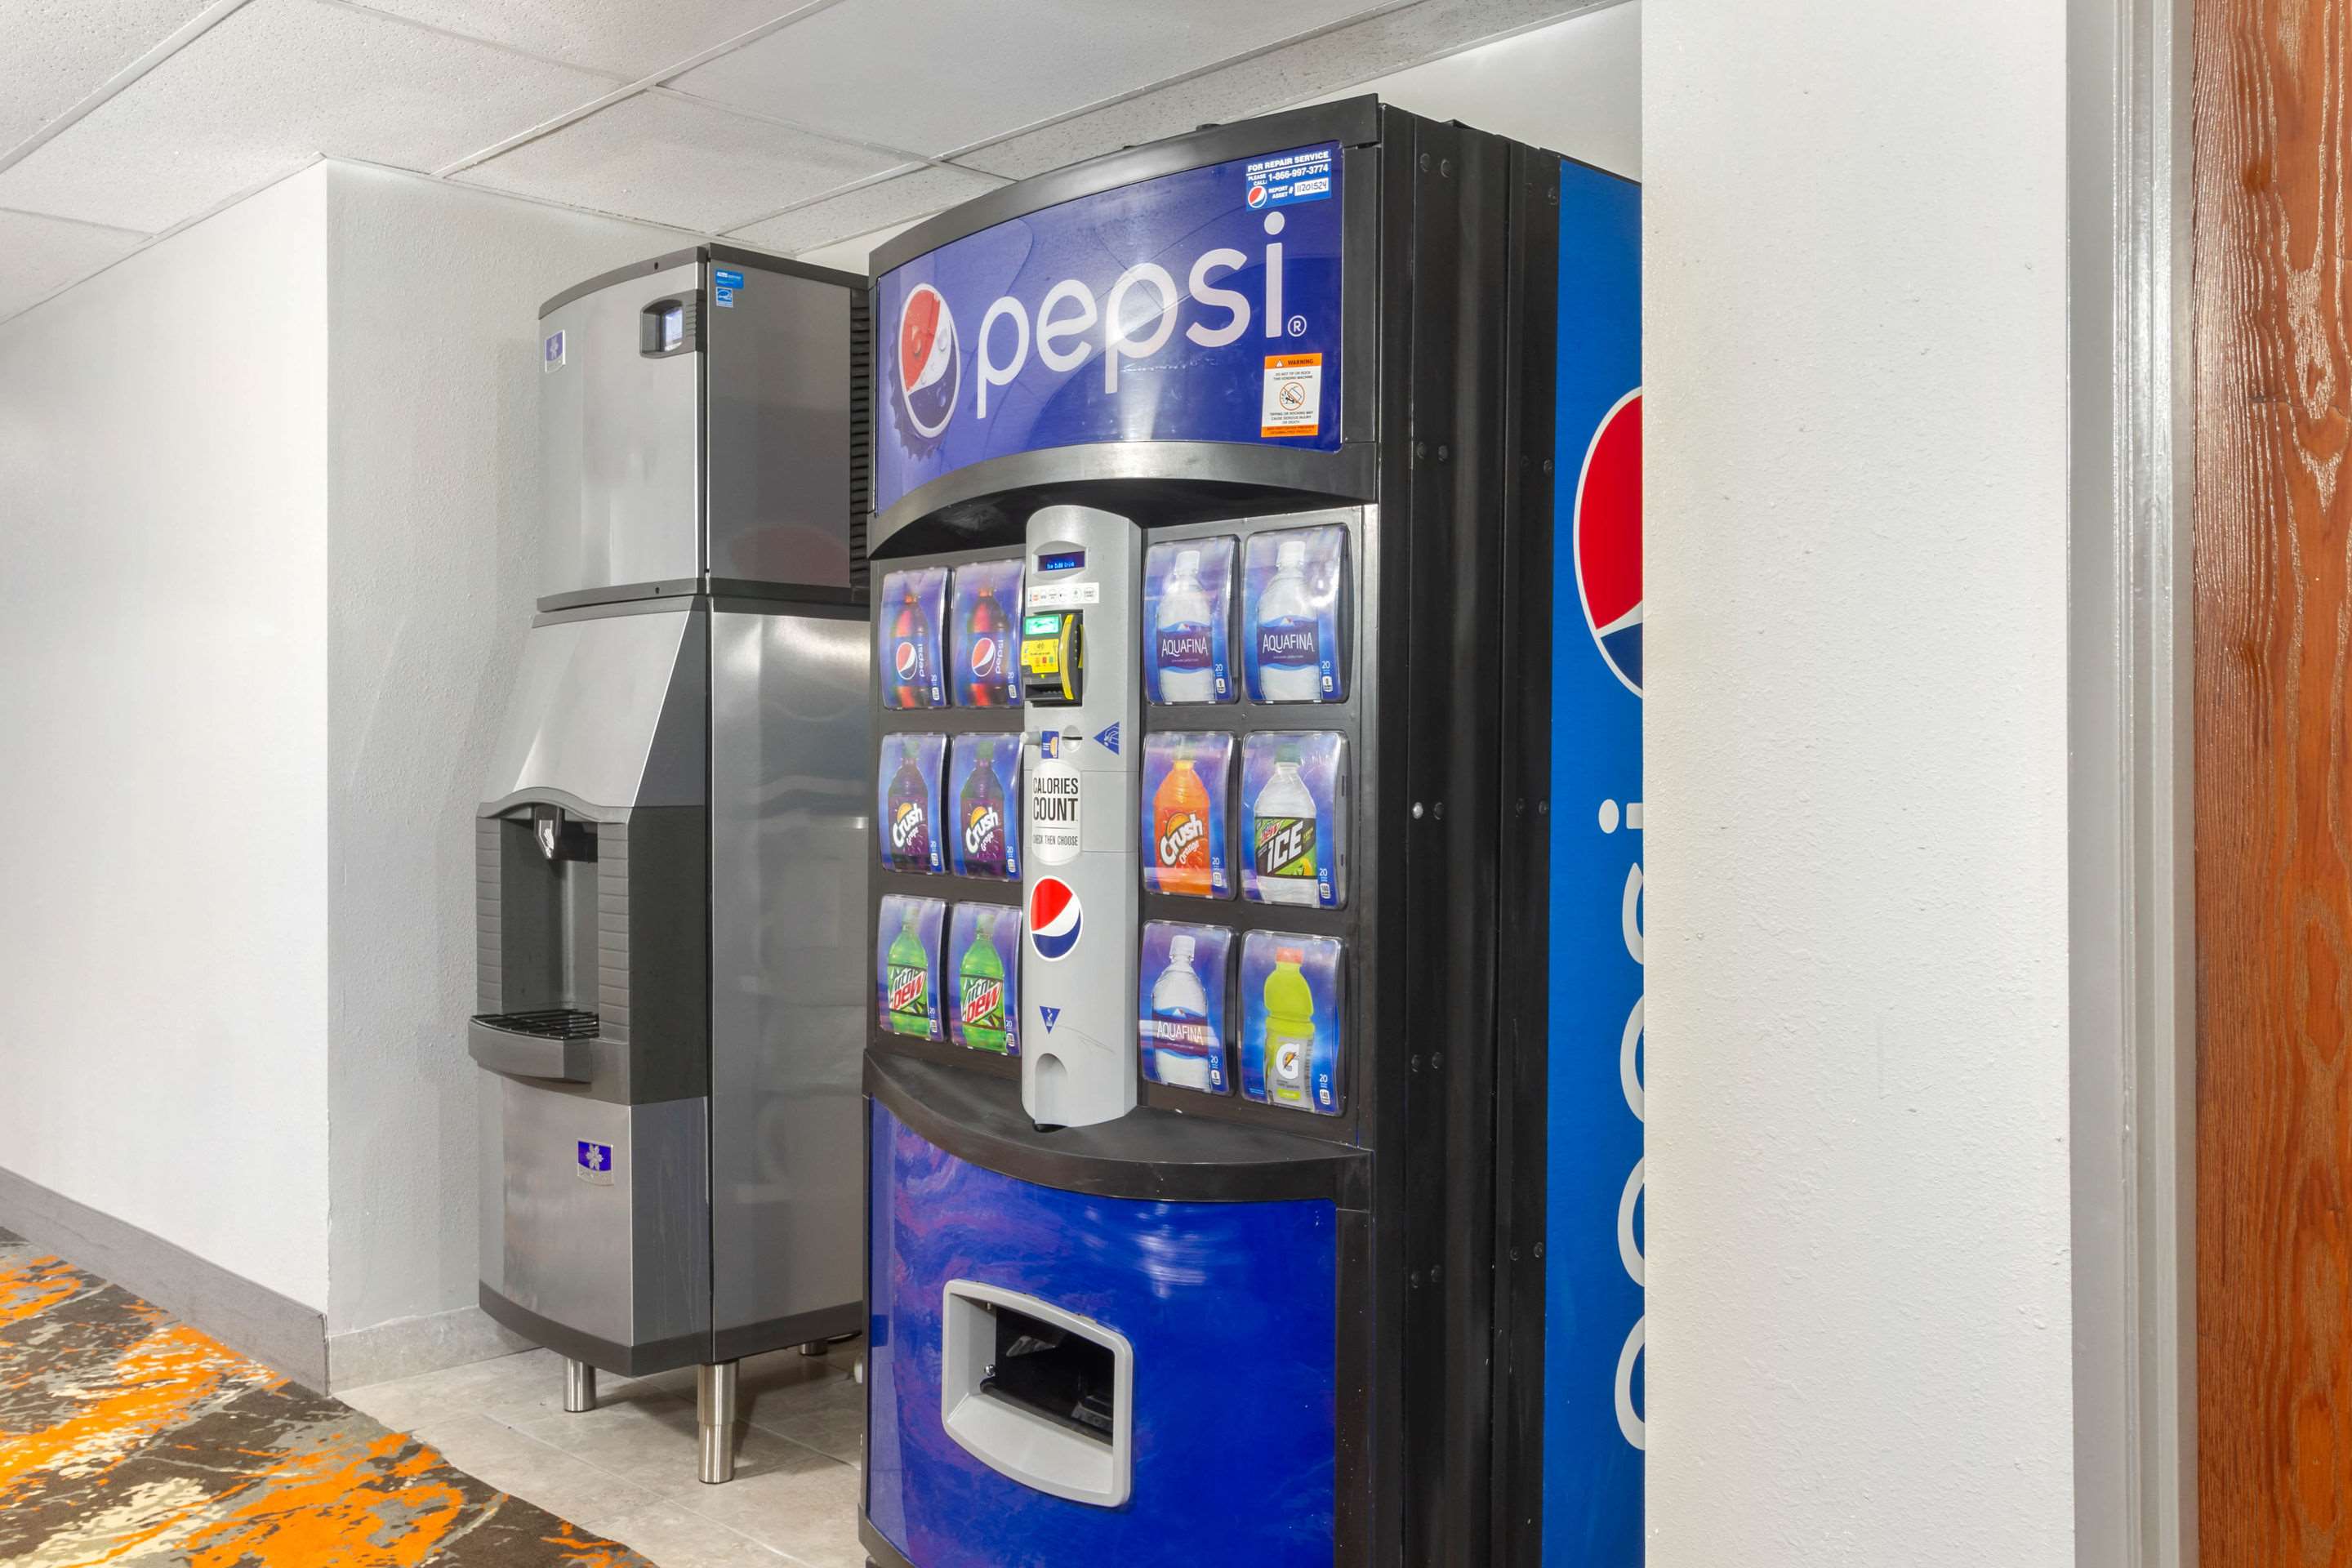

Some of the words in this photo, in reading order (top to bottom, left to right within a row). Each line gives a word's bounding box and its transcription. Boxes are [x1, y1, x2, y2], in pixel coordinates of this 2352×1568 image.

[1248, 164, 1263, 172] FOR
[1265, 158, 1293, 169] REPAIR
[1294, 151, 1329, 163] SERVICE
[1268, 164, 1329, 181] 1-866-997-3774
[977, 212, 1286, 419] pepsi
[1161, 636, 1209, 657] AQUAFINA
[1262, 632, 1316, 653] AQUAFINA
[996, 639, 1004, 674] pepsi
[1215, 663, 1223, 672] 20
[1321, 660, 1330, 669] 20
[1033, 777, 1078, 795] CALORIES
[1033, 797, 1078, 822] COUNT
[893, 803, 923, 848] Crush
[966, 806, 999, 853] Crush
[1045, 835, 1055, 844] THEN
[1058, 835, 1078, 846] CHOOSE
[1160, 813, 1203, 865] Crush
[1267, 821, 1303, 873] ICE
[1156, 1020, 1204, 1045] AQUAFINA
[1276, 1043, 1300, 1080] G
